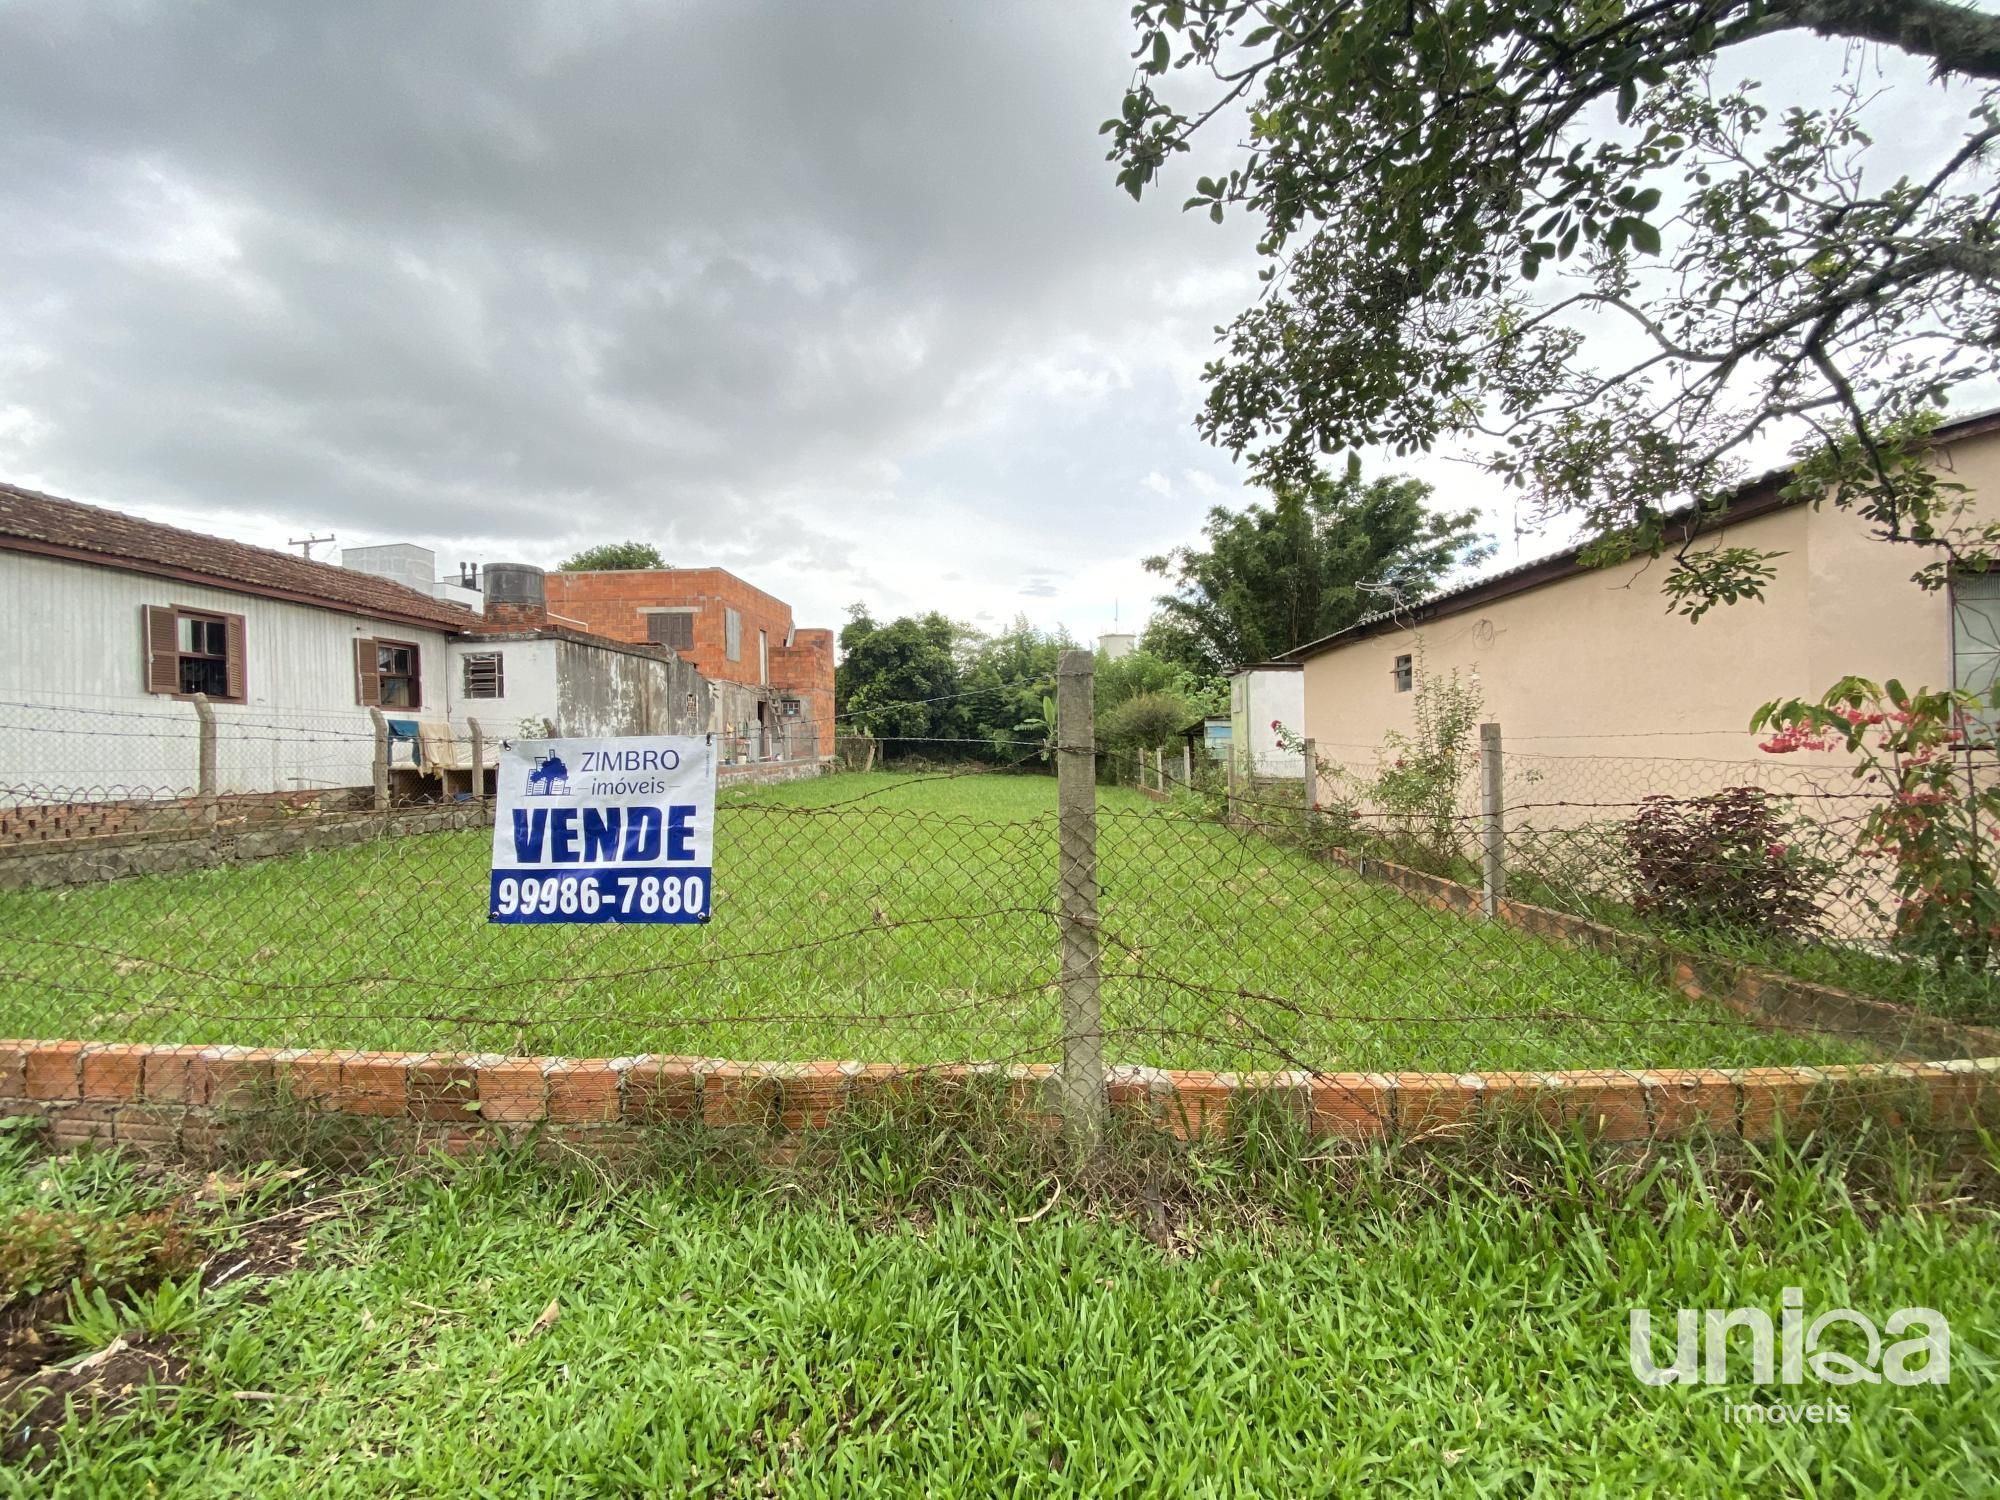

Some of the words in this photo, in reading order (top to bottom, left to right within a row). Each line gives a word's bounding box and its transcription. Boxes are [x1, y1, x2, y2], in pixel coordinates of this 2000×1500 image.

[580, 750, 680, 772] ZIMBRO
[591, 777, 665, 795] imóveis
[512, 805, 697, 863] VENDE
[498, 876, 704, 915] 99986-7880
